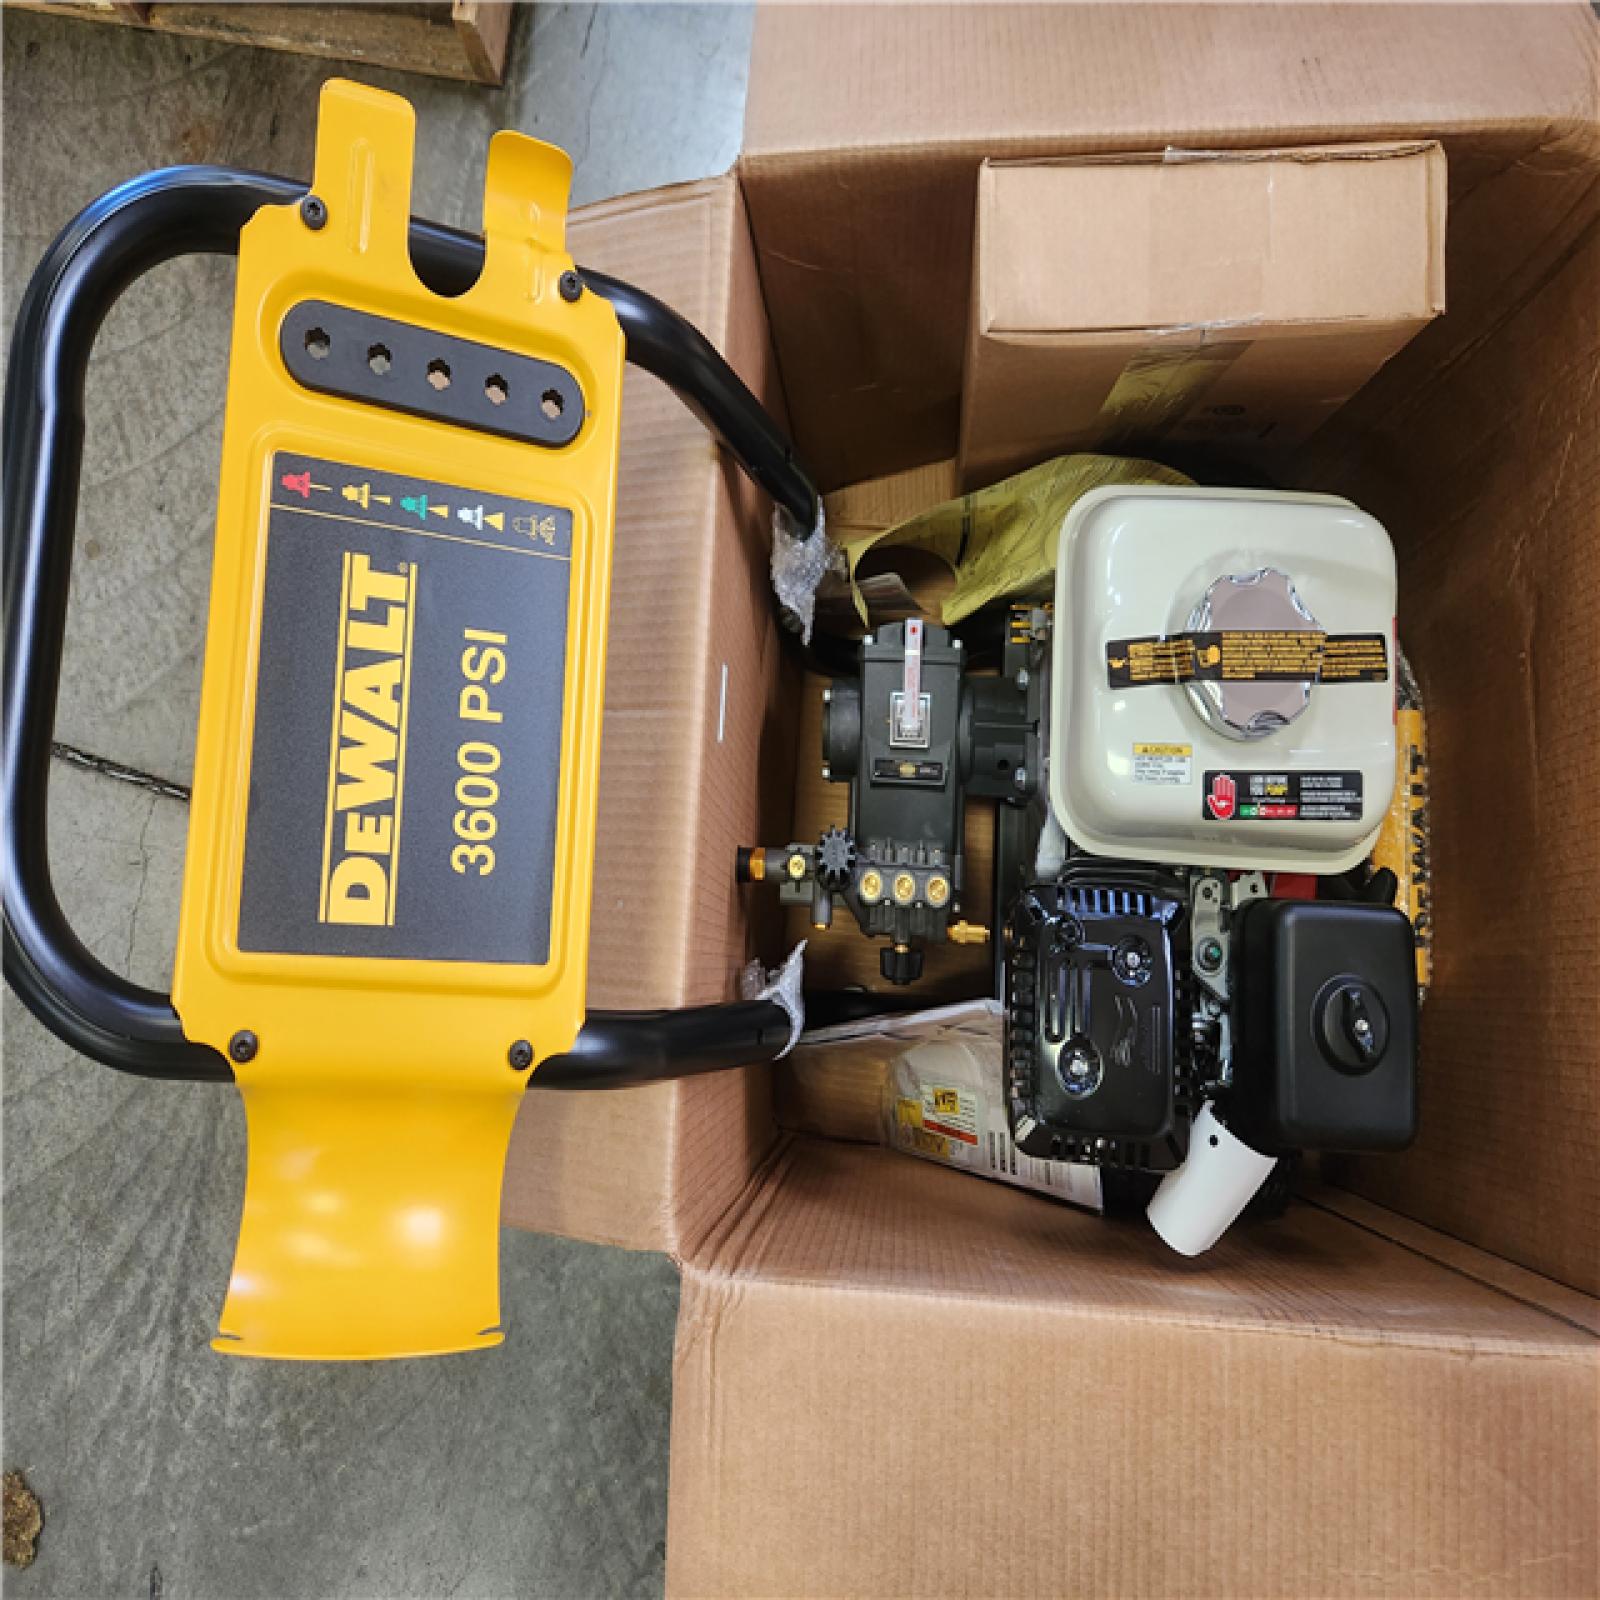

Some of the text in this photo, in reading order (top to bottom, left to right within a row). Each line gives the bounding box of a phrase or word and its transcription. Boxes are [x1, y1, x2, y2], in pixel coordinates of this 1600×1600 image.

[326, 553, 409, 925] DEWALT
[450, 628, 508, 877] 3600 PSI
